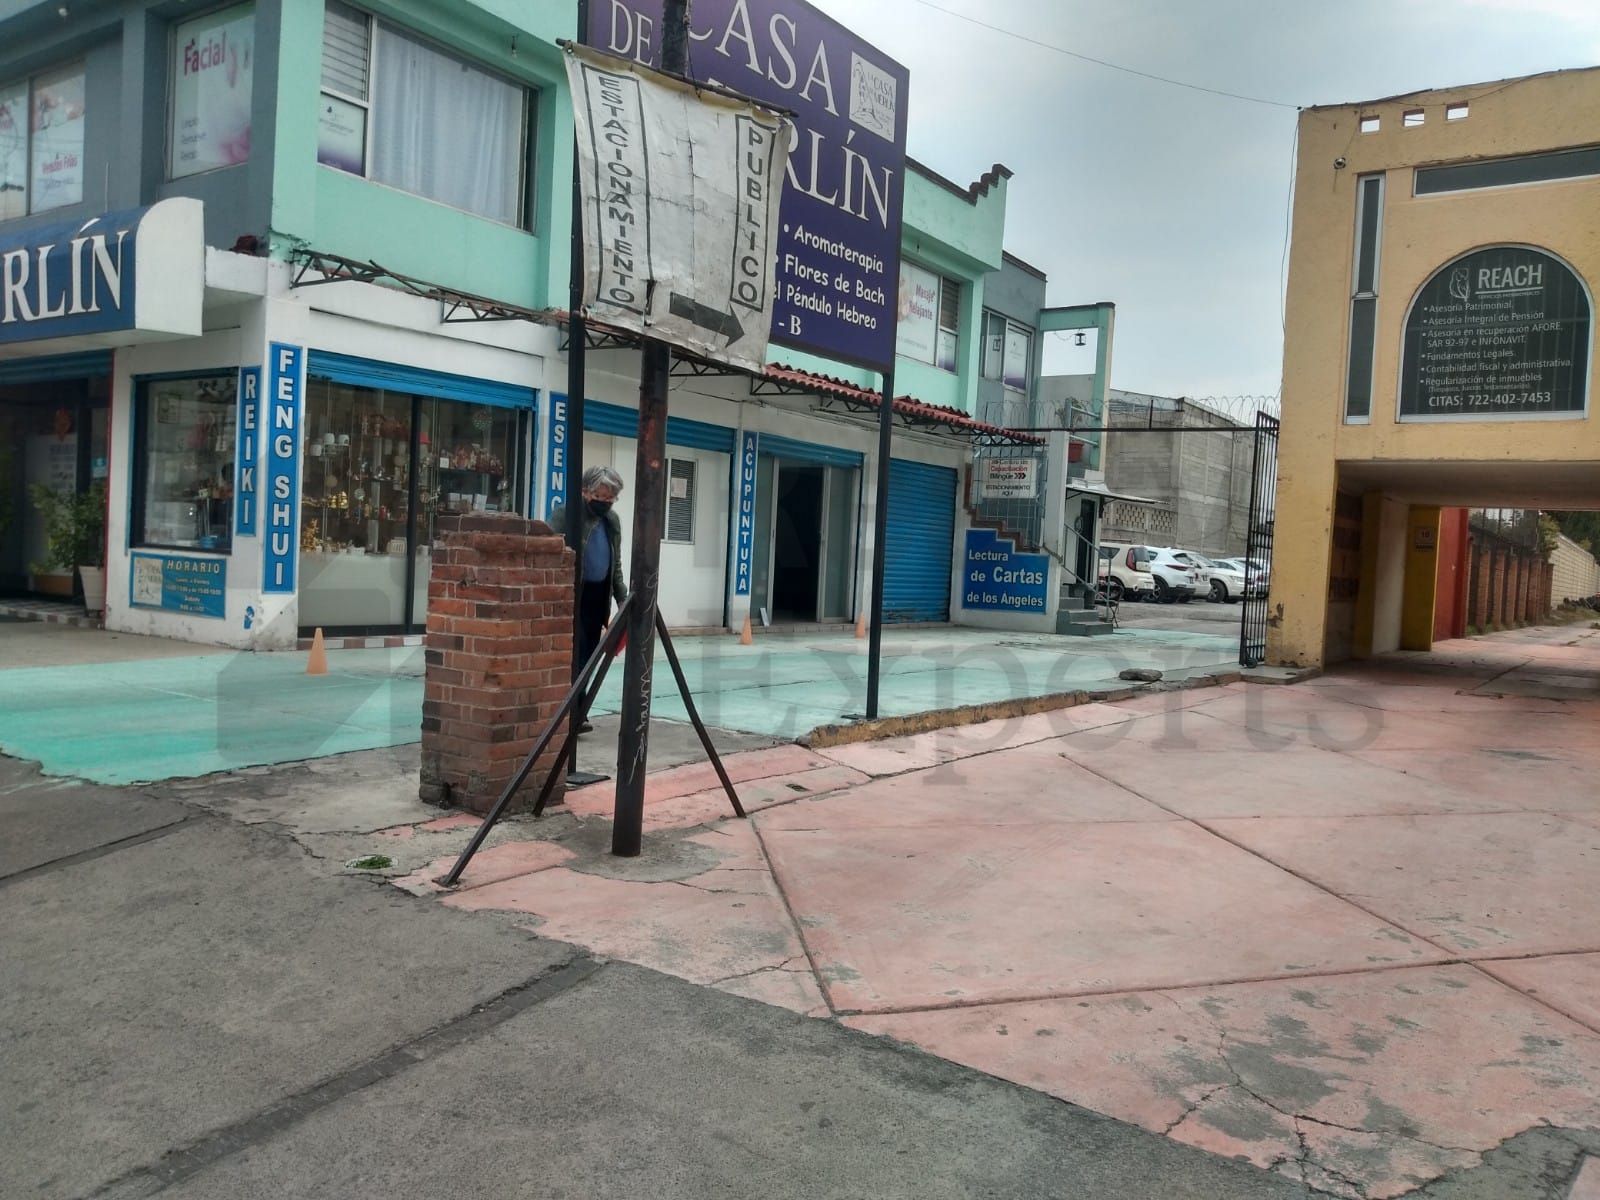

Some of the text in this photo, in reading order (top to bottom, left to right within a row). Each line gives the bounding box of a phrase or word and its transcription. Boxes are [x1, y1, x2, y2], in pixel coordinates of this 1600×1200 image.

[608, 0, 653, 66] DE
[598, 76, 635, 304] ESTACIONAMIENTO
[738, 128, 764, 303] PUBLICO
[794, 224, 883, 273] Aromaterapia
[1, 217, 129, 324] RLÍN
[785, 254, 885, 306] Flores de Bach
[1478, 264, 1543, 289] REACH
[787, 283, 832, 316] Péndulo
[837, 301, 877, 330] Hebreo
[1429, 303, 1463, 313] Asesoría
[1428, 311, 1545, 326] Asesoría Integral de Pensión
[1427, 329, 1462, 339] Asesoría
[1427, 339, 1443, 348] SAR
[1427, 351, 1481, 361] Fundamentos
[1426, 363, 1477, 374] Contabilidad
[1479, 361, 1500, 371] fiscal
[1487, 374, 1497, 384] de
[1429, 392, 1551, 408] CITAS: 722-402-7453
[241, 373, 257, 525] REIKI
[272, 348, 295, 586] FENG SHUI
[738, 437, 754, 591] ACUPUNTURA
[968, 549, 1009, 562] Lectura
[167, 559, 220, 574] HORARIO
[971, 566, 1043, 585] de Cartas
[967, 592, 980, 603] de
[982, 592, 998, 604] los
